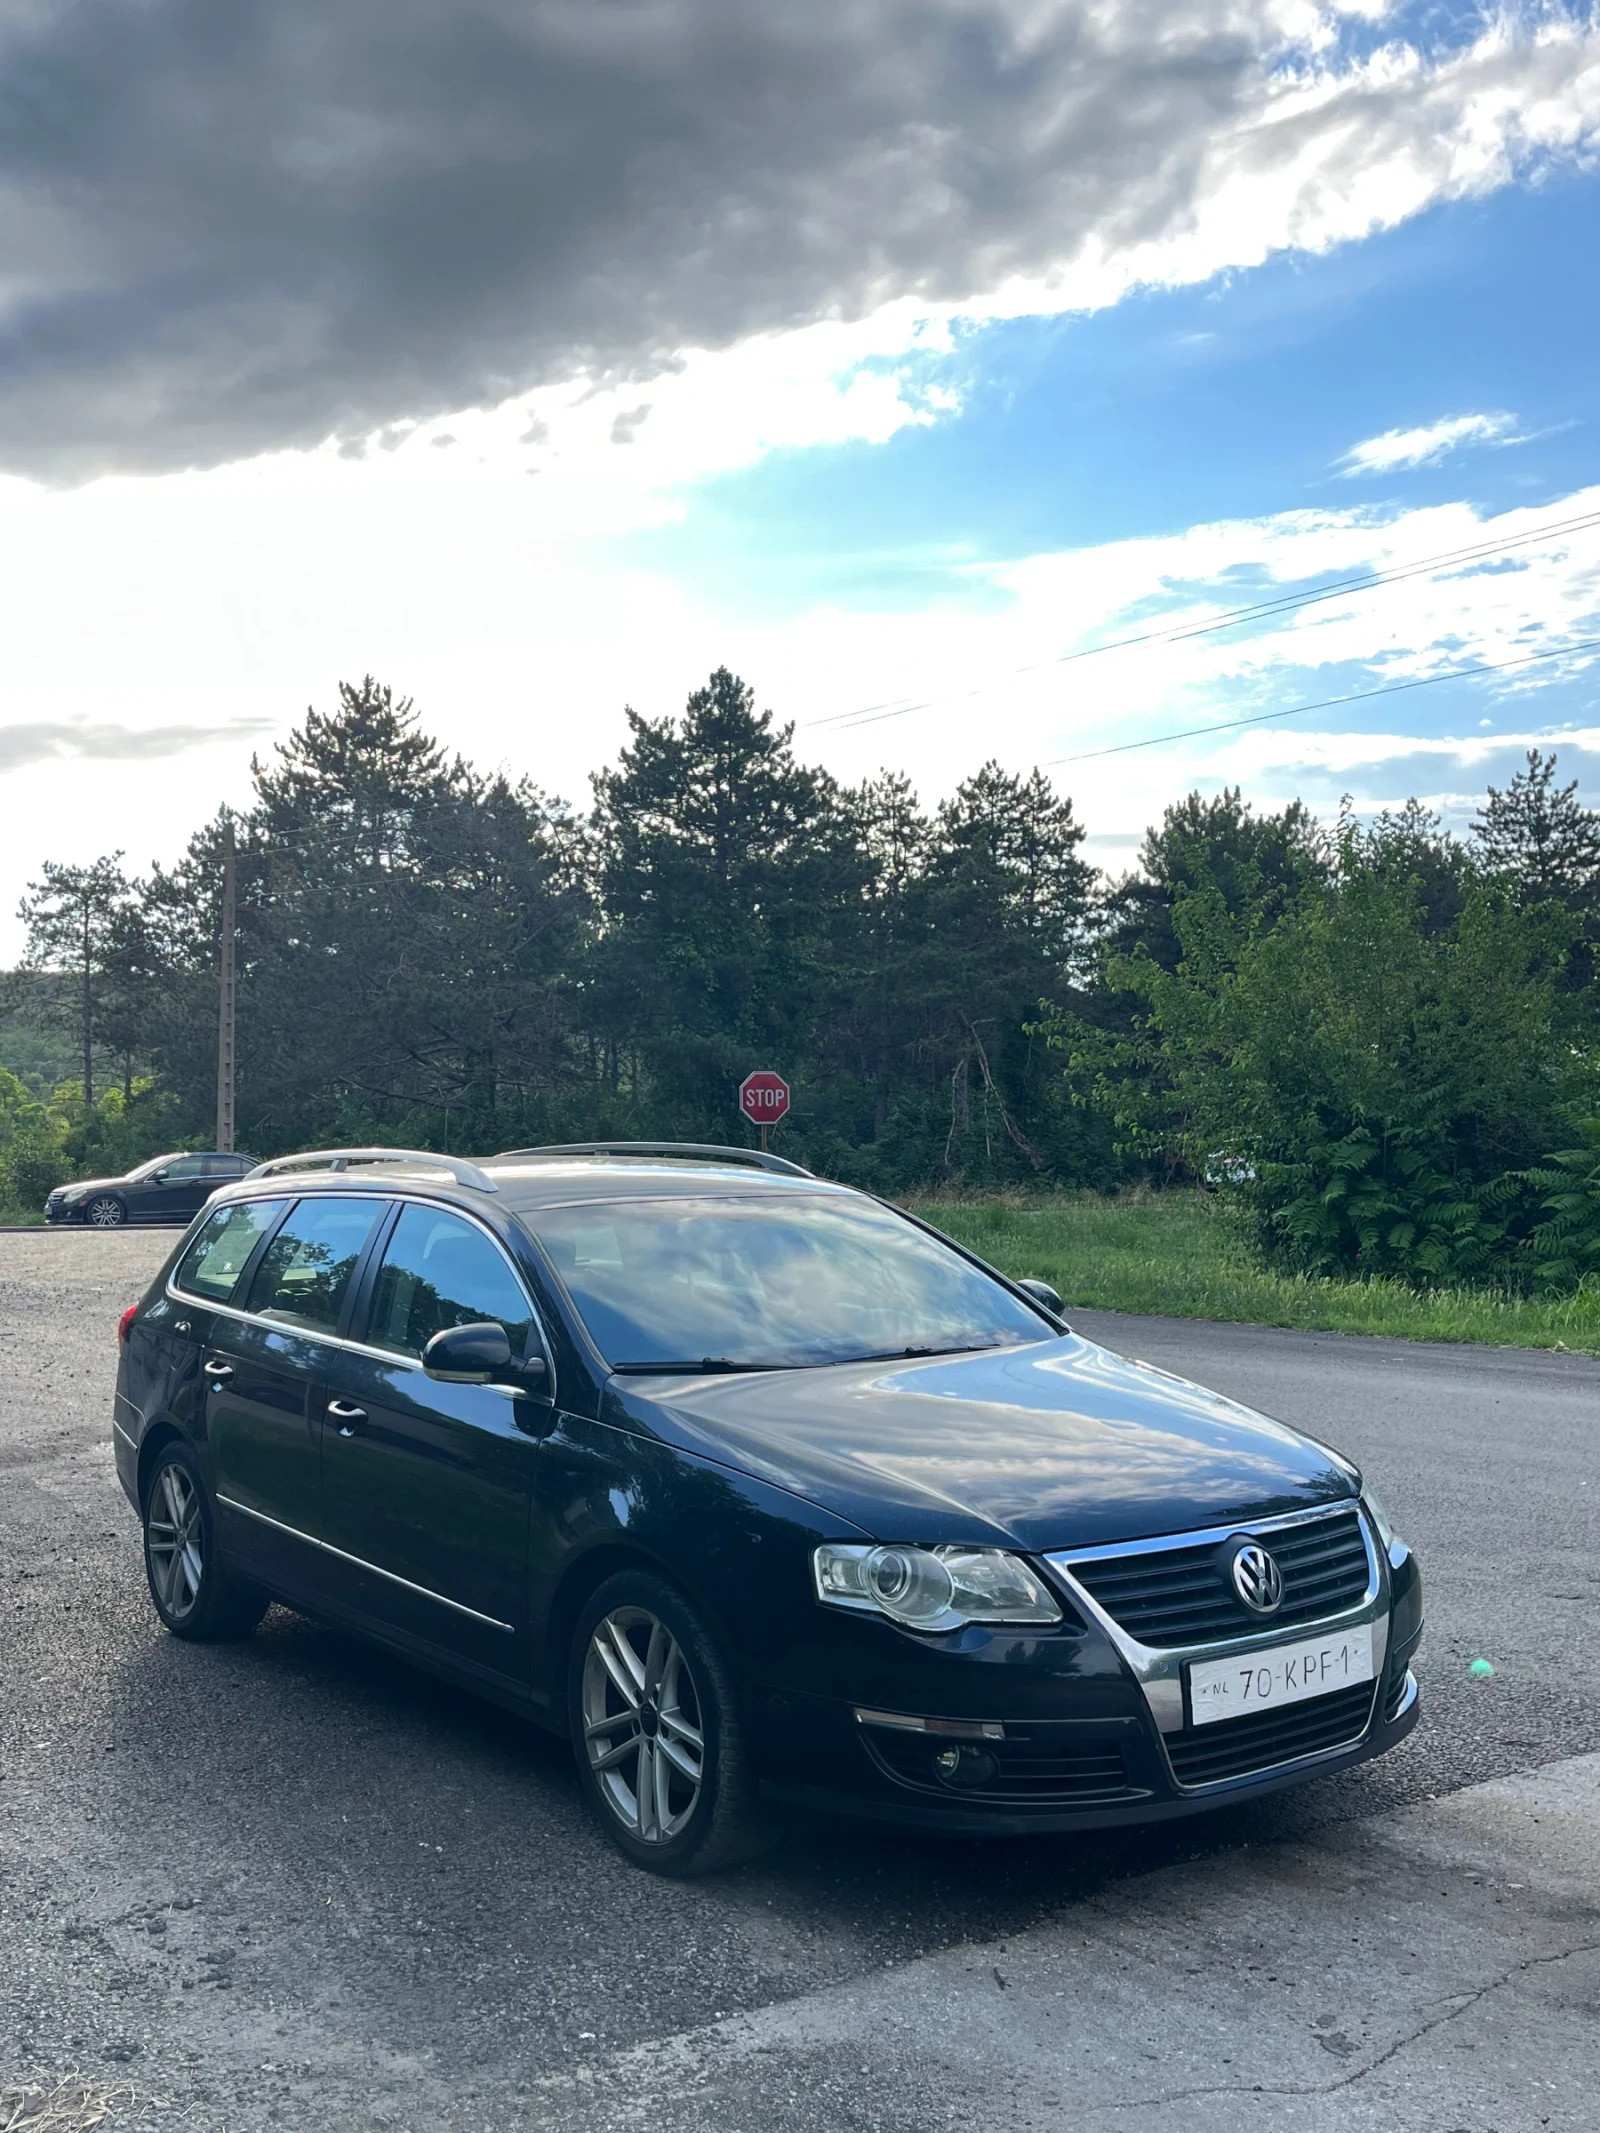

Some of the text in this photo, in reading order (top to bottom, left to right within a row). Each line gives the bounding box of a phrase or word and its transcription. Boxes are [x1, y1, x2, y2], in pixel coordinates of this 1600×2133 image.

[746, 1089, 785, 1107] STOP
[1235, 1546, 1281, 1611] VW
[1213, 1645, 1348, 1699] NL 70-KPF-1
